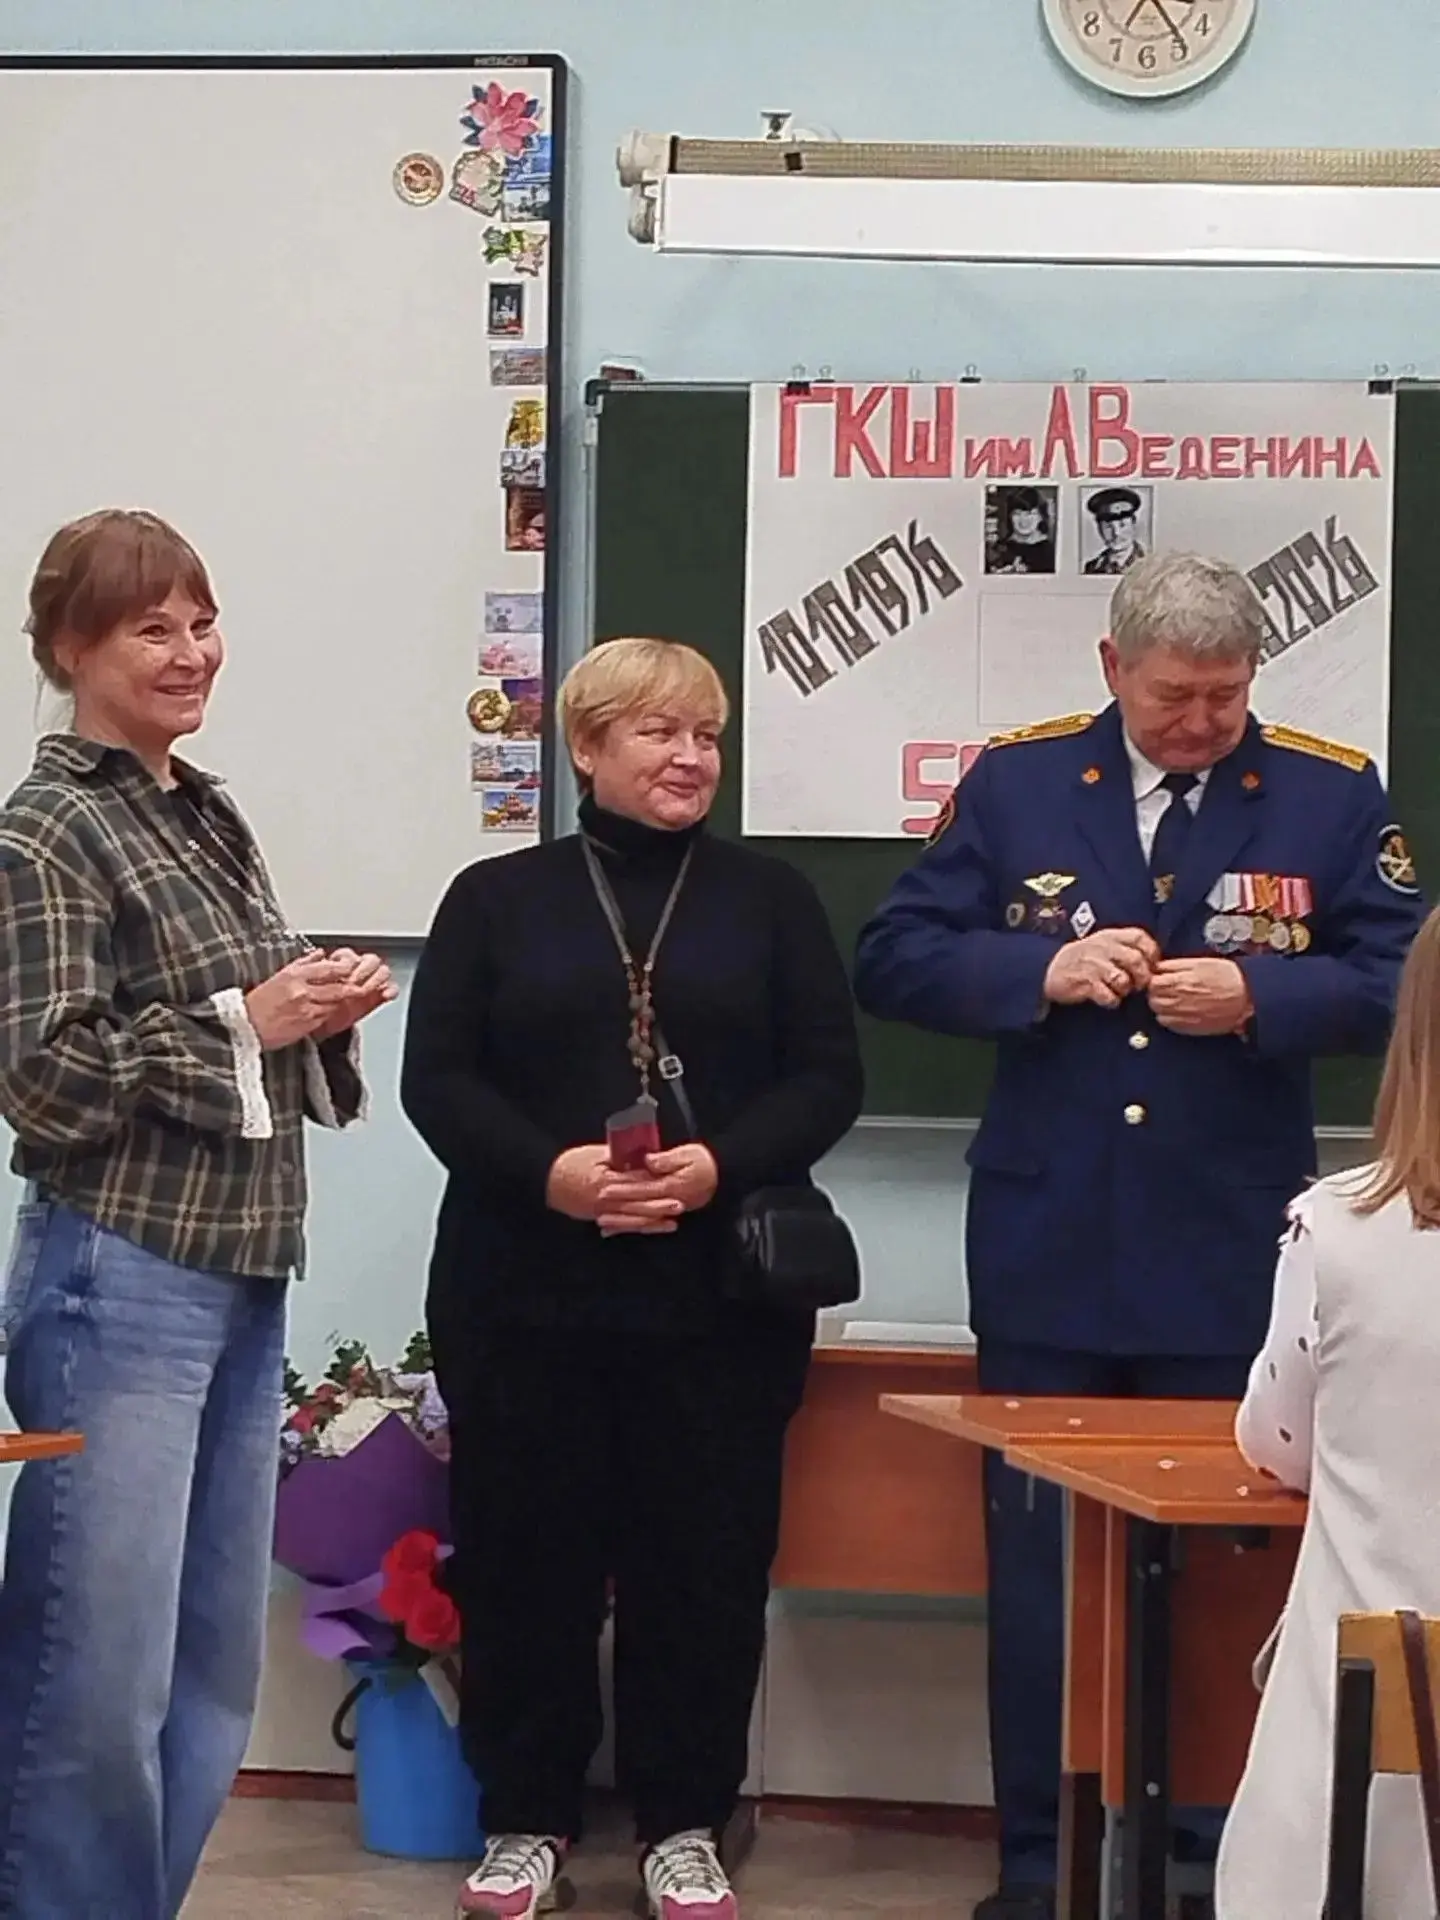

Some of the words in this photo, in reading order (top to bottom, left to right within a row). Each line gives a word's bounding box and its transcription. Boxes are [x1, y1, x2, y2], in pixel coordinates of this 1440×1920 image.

[1083, 11, 1100, 37] 8
[1194, 13, 1210, 36] 4
[1108, 38, 1123, 62] 7
[1138, 45, 1156, 69] 6
[779, 386, 954, 477] ГКШ
[902, 743, 984, 834] 5
